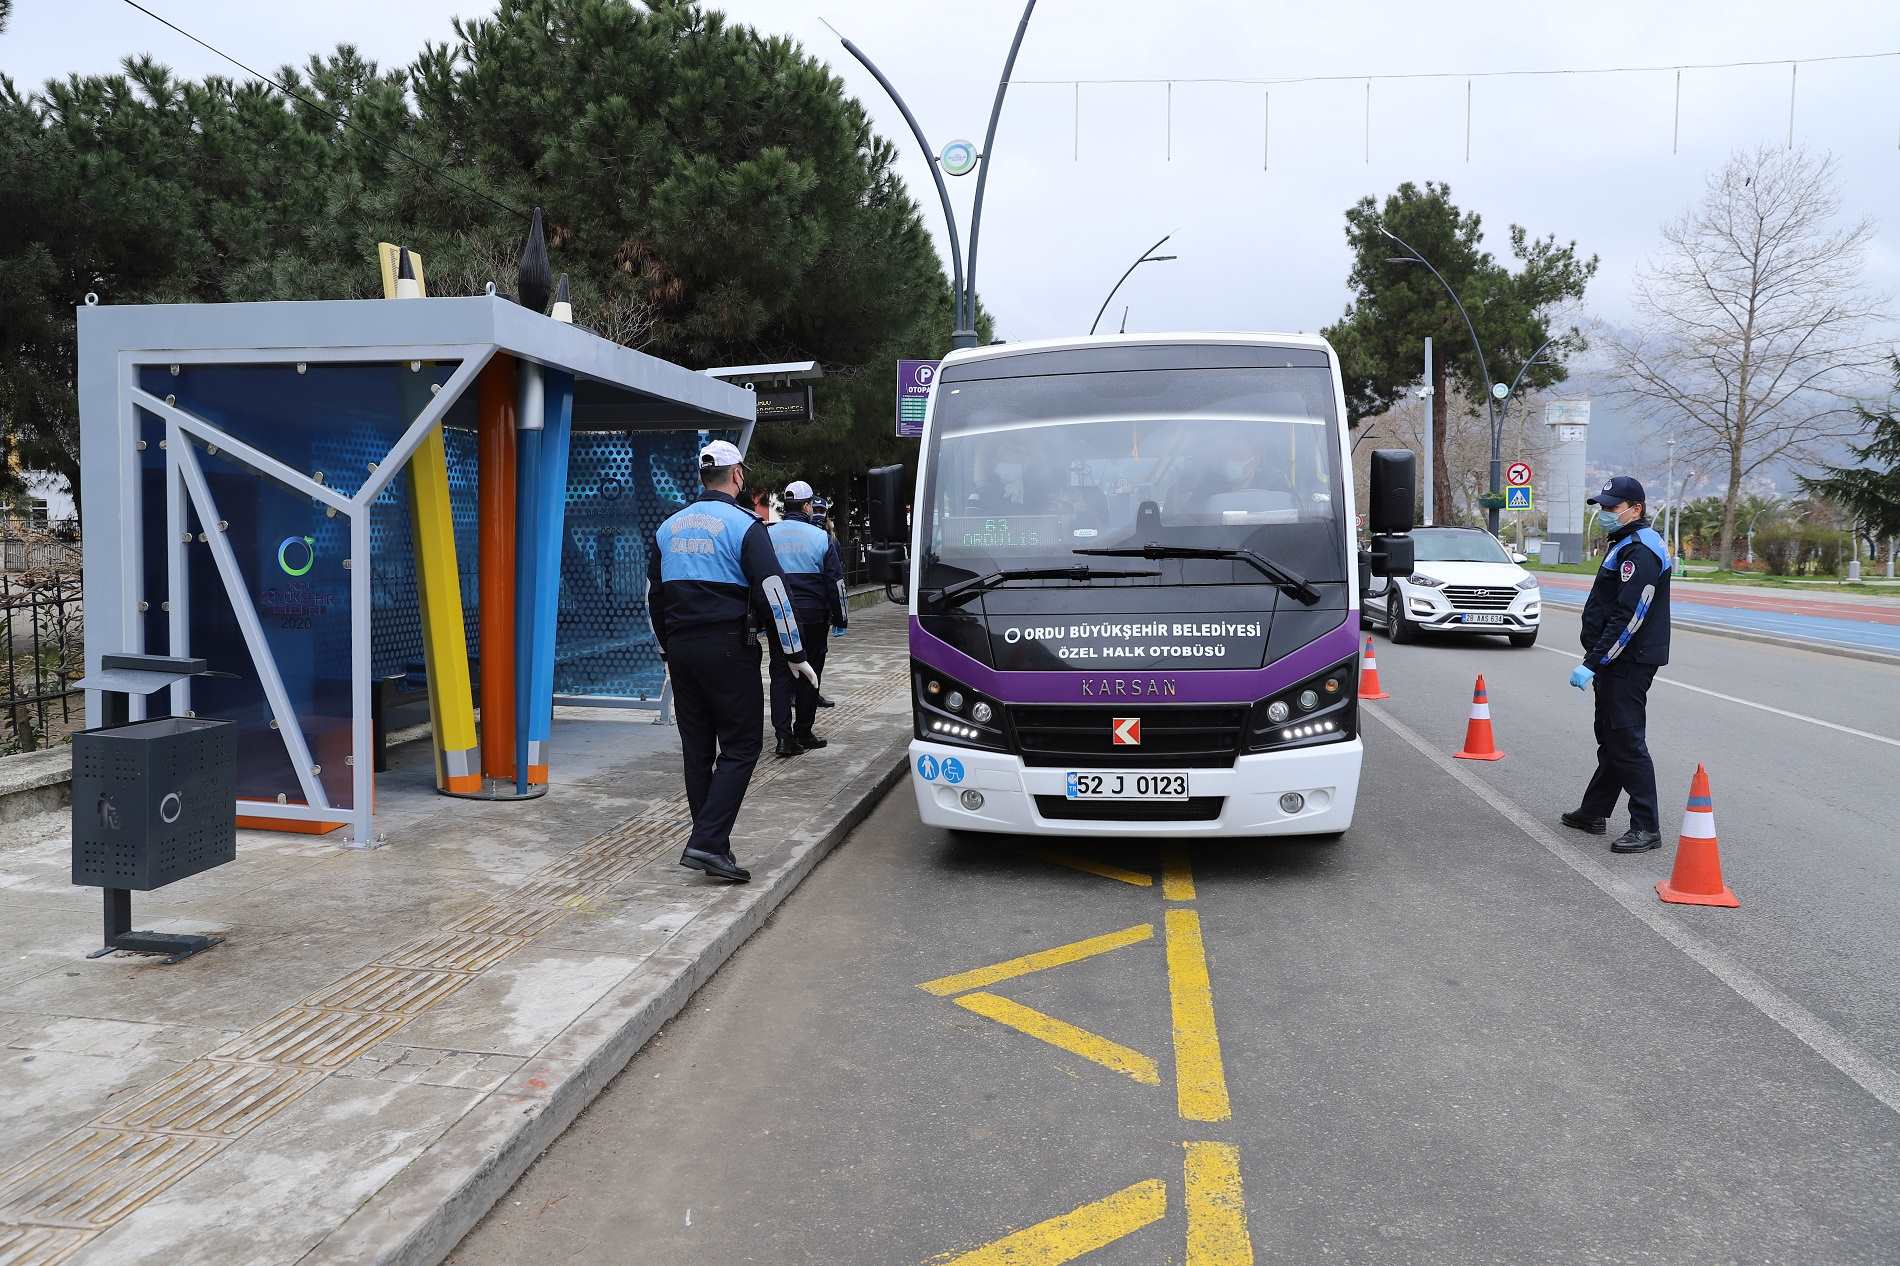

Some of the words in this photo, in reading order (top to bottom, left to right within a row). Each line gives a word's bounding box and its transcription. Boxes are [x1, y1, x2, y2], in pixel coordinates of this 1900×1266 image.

[1024, 626, 1065, 640] ORDU
[1069, 621, 1168, 640] BÜYÜKŞEHİR
[1172, 621, 1261, 637] BELEDİYESİ
[1058, 646, 1098, 659] ÖZEL
[1103, 645, 1145, 657] HALK
[1149, 643, 1226, 657] OTOBÜSÜ
[1082, 679, 1177, 696] KARSAN
[1077, 775, 1103, 794] 52
[1111, 775, 1124, 794] J
[1136, 775, 1186, 795] 0123
